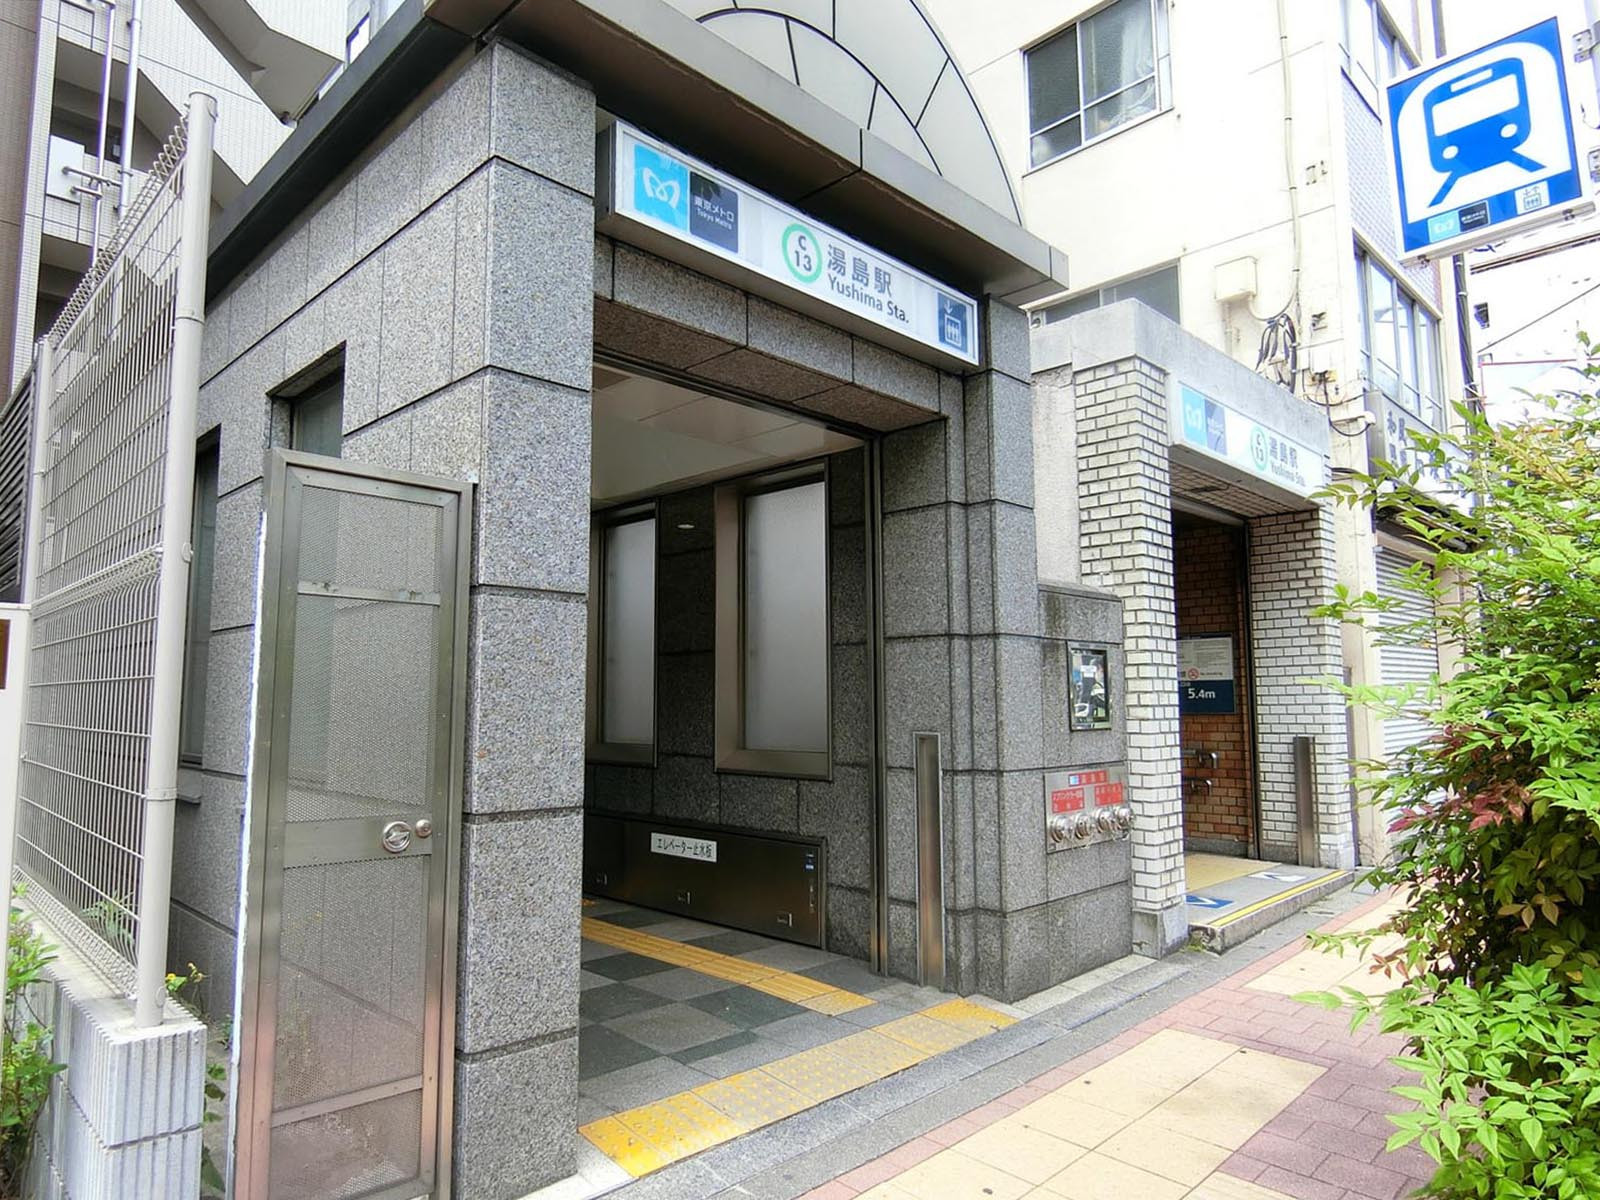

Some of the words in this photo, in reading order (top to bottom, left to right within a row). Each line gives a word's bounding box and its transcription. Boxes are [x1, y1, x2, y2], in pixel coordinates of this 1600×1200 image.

[798, 235, 807, 252] C
[794, 249, 812, 272] 13
[827, 243, 892, 298] 湯島駅
[827, 272, 883, 312] Yushima
[887, 300, 909, 324] Sta.
[1187, 687, 1216, 699] 5.4m
[656, 838, 712, 858] エレベーター止水板
